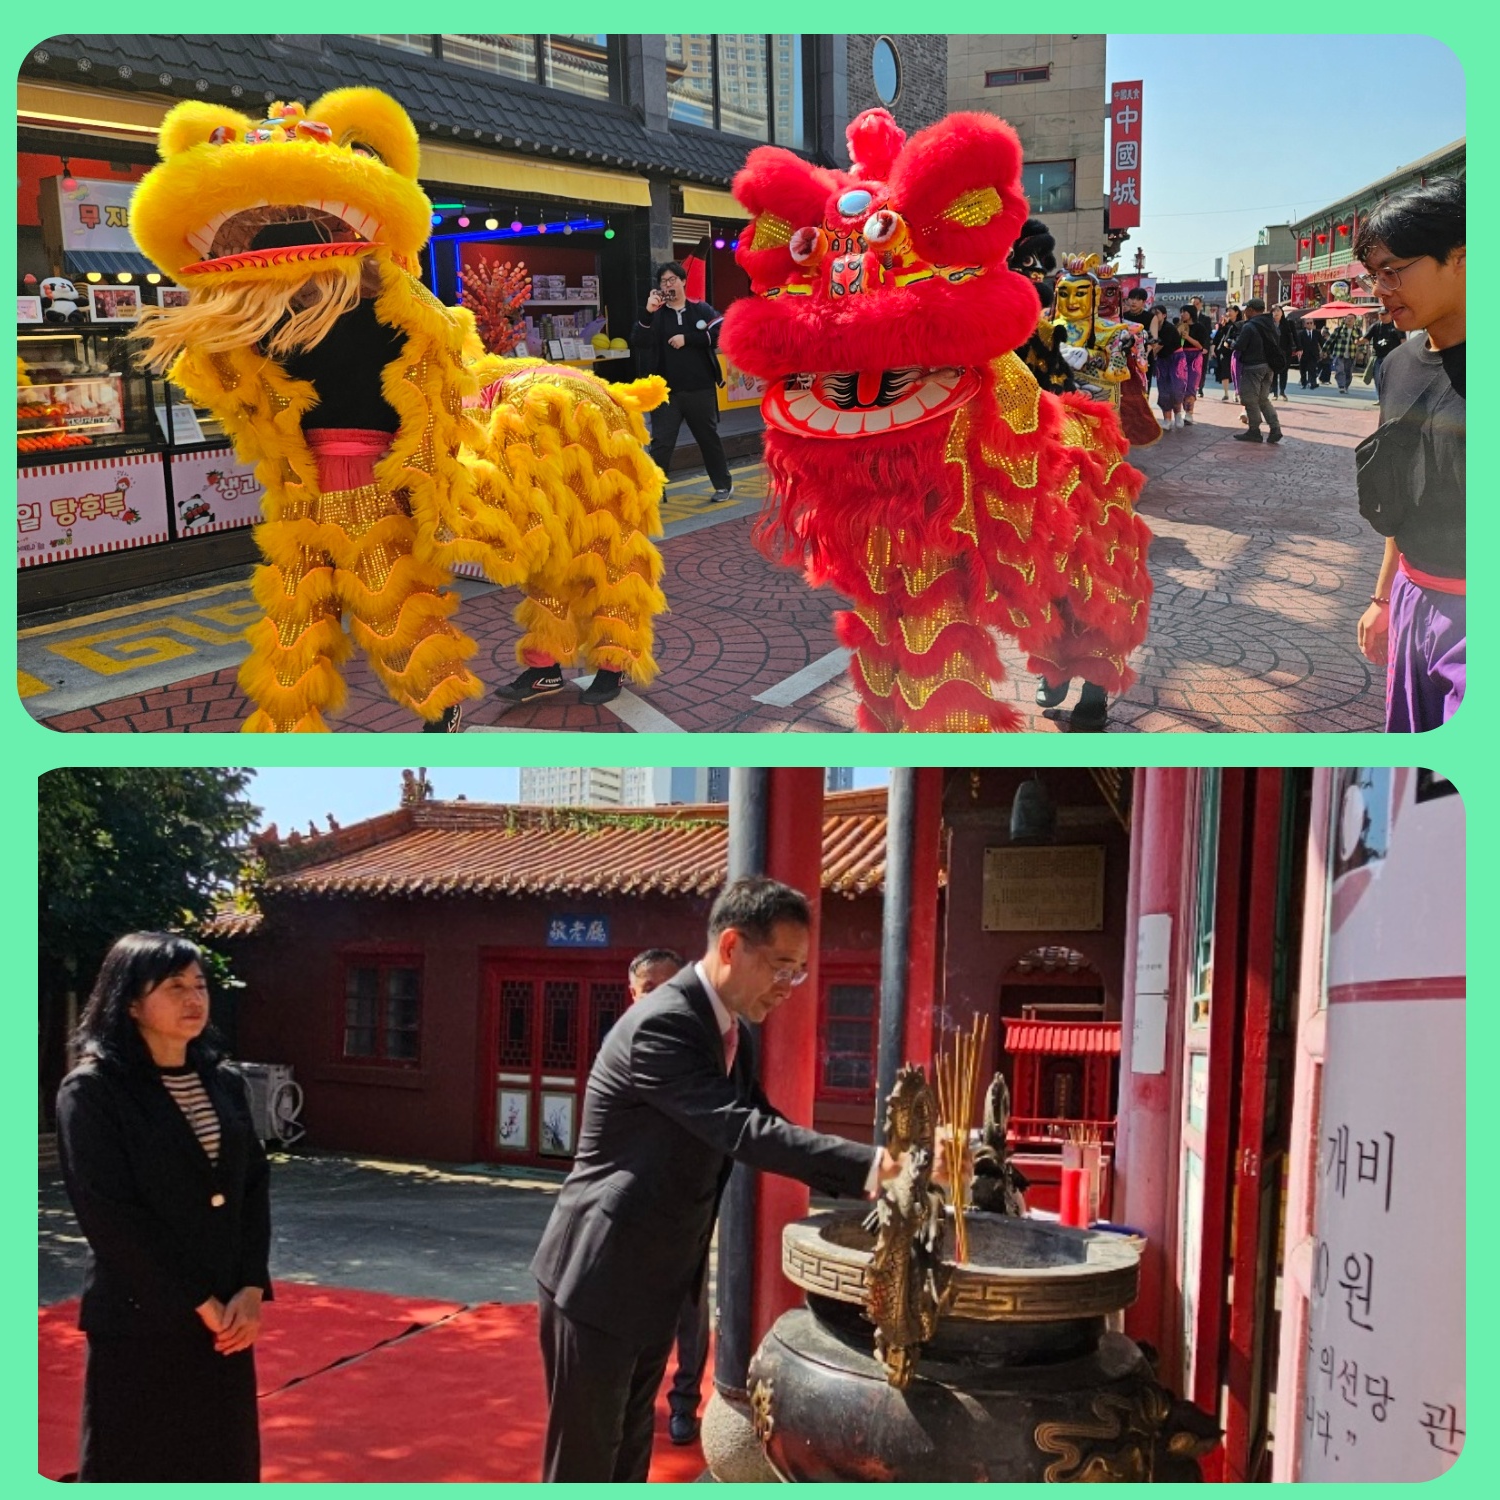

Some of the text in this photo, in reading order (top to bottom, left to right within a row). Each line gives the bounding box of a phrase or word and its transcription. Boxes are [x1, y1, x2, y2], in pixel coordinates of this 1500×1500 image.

[1112, 104, 1139, 206] 中國城
[50, 491, 127, 527] 탕후루
[1338, 1253, 1374, 1331] 원
[1319, 1346, 1396, 1422] 의선당
